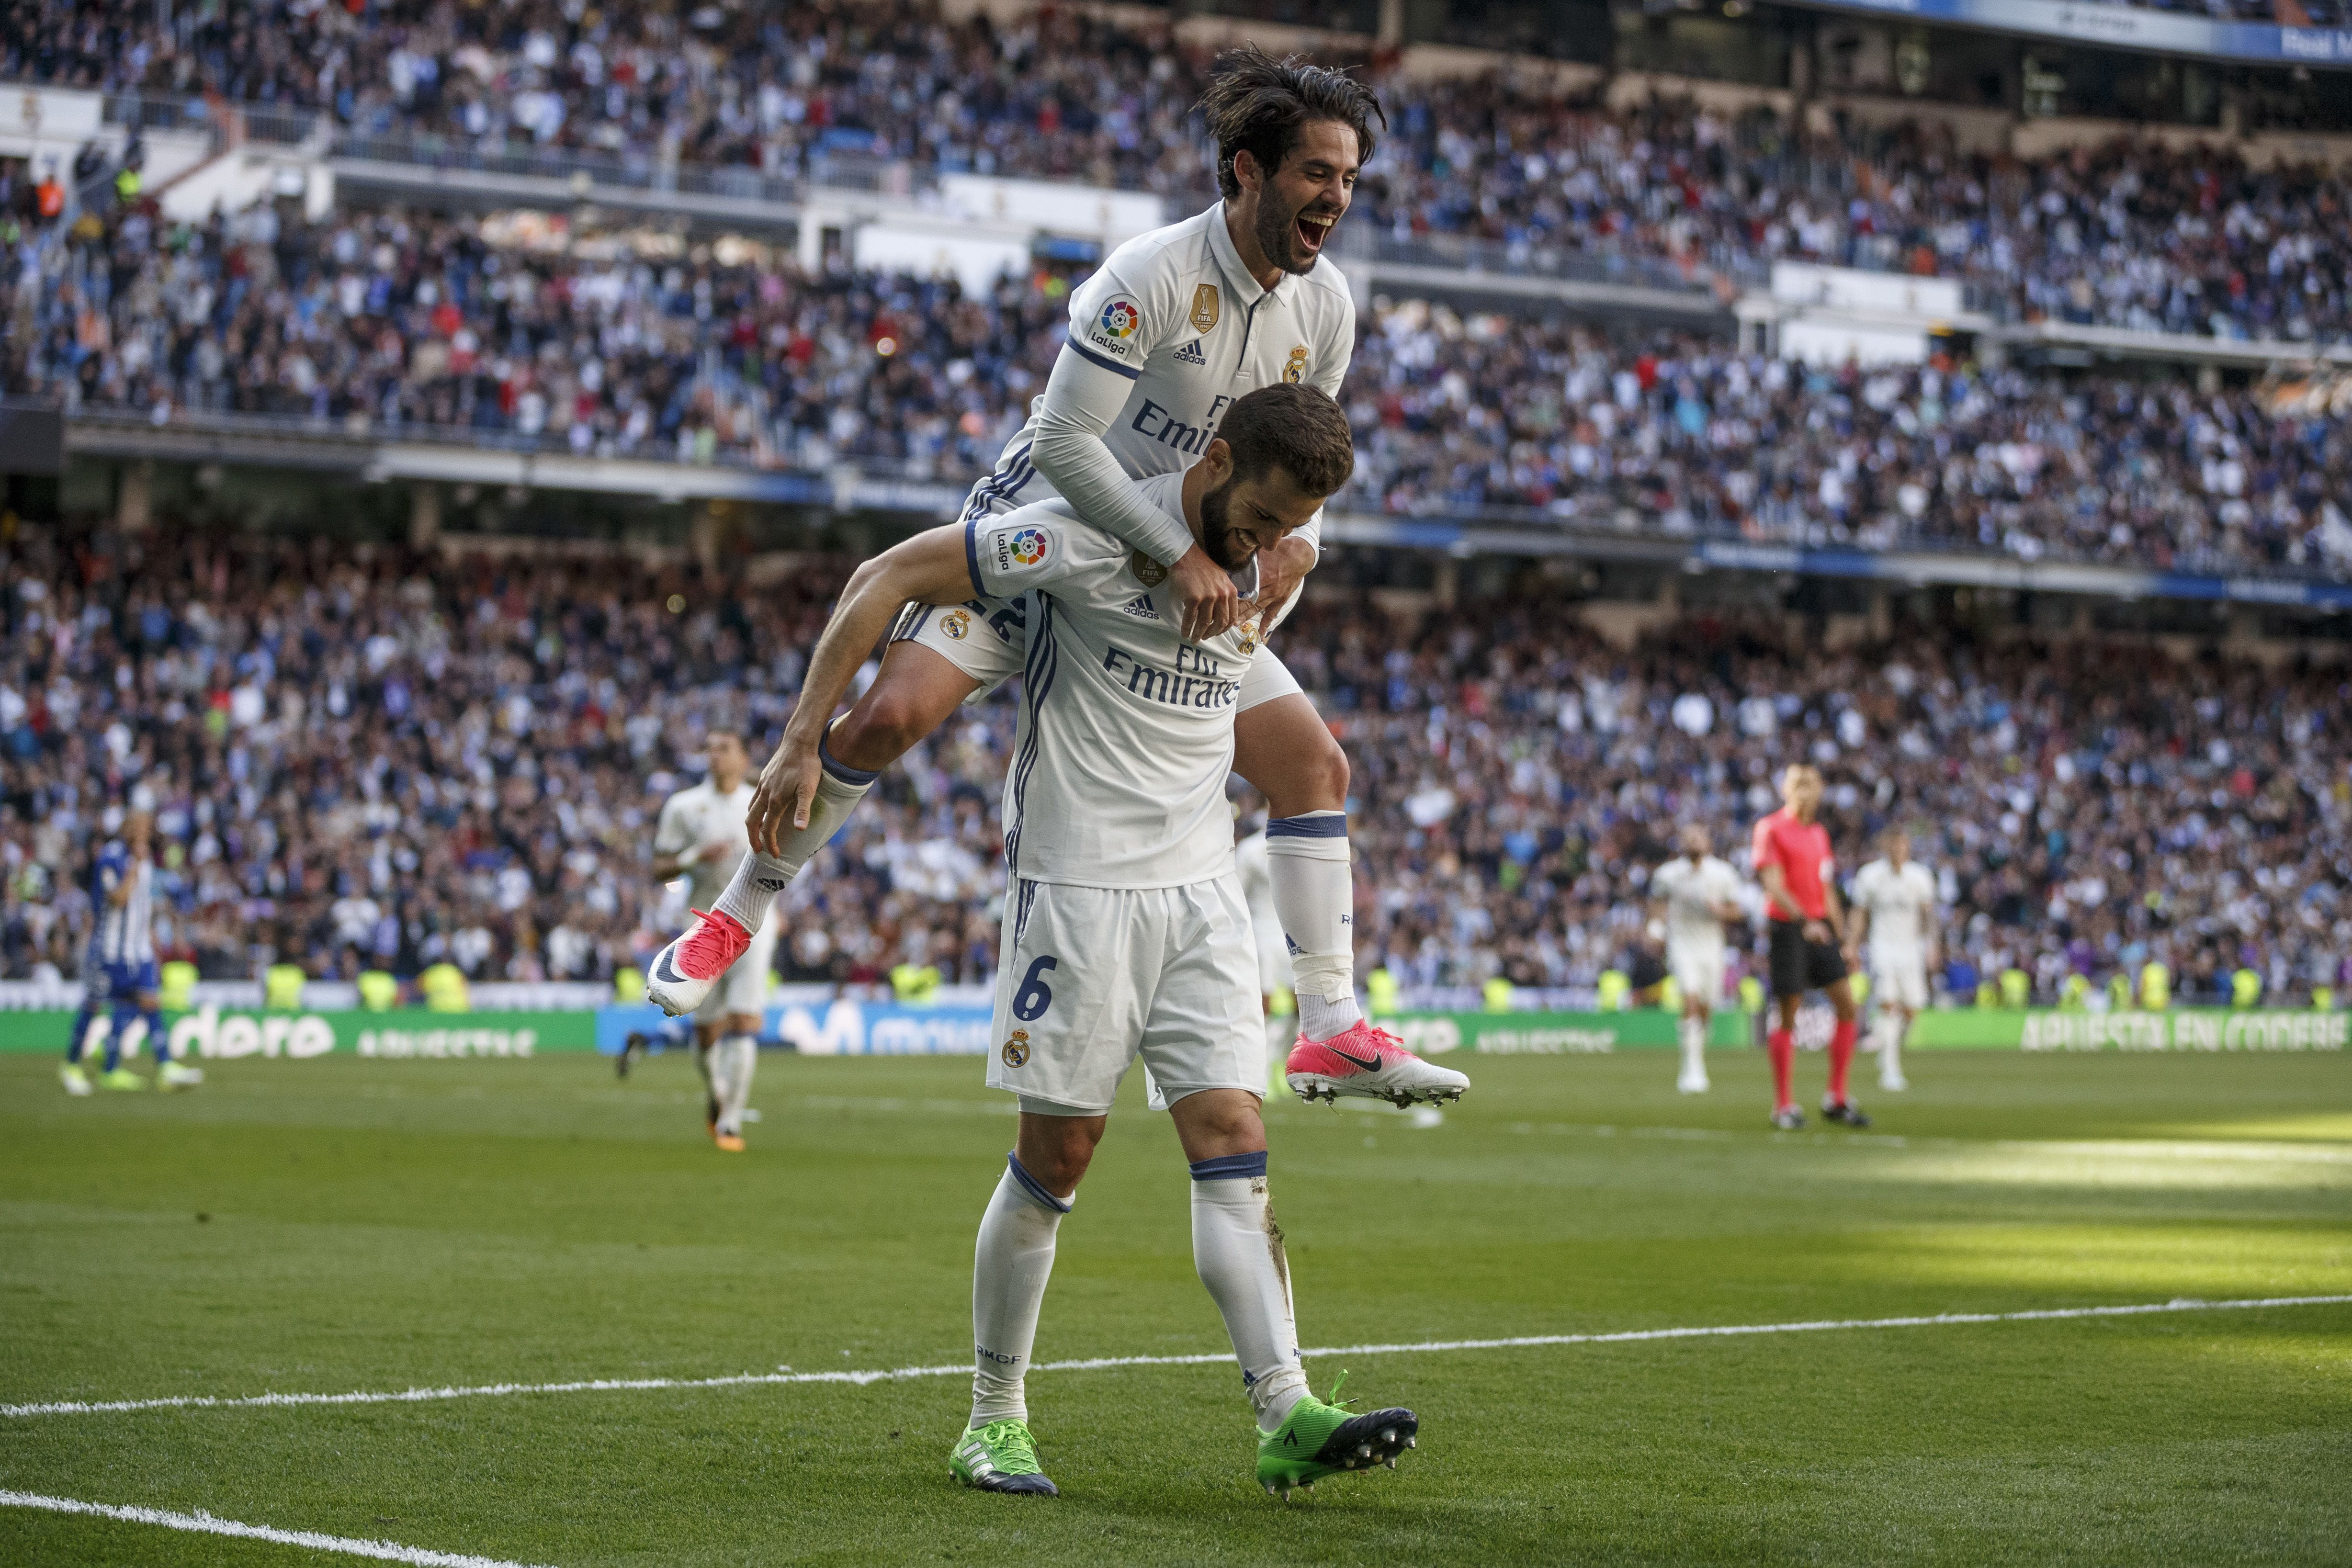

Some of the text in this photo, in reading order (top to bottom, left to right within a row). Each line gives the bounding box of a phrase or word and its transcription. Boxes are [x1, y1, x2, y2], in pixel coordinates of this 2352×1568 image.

[1091, 332, 1126, 355] LaLiga
[1173, 352, 1206, 365] adidas
[997, 533, 1009, 570] LaLiga
[1123, 607, 1159, 620] adidas
[1102, 645, 1240, 709] Emirate
[1012, 955, 1058, 1022] 6
[977, 1344, 1022, 1365] RMCF
